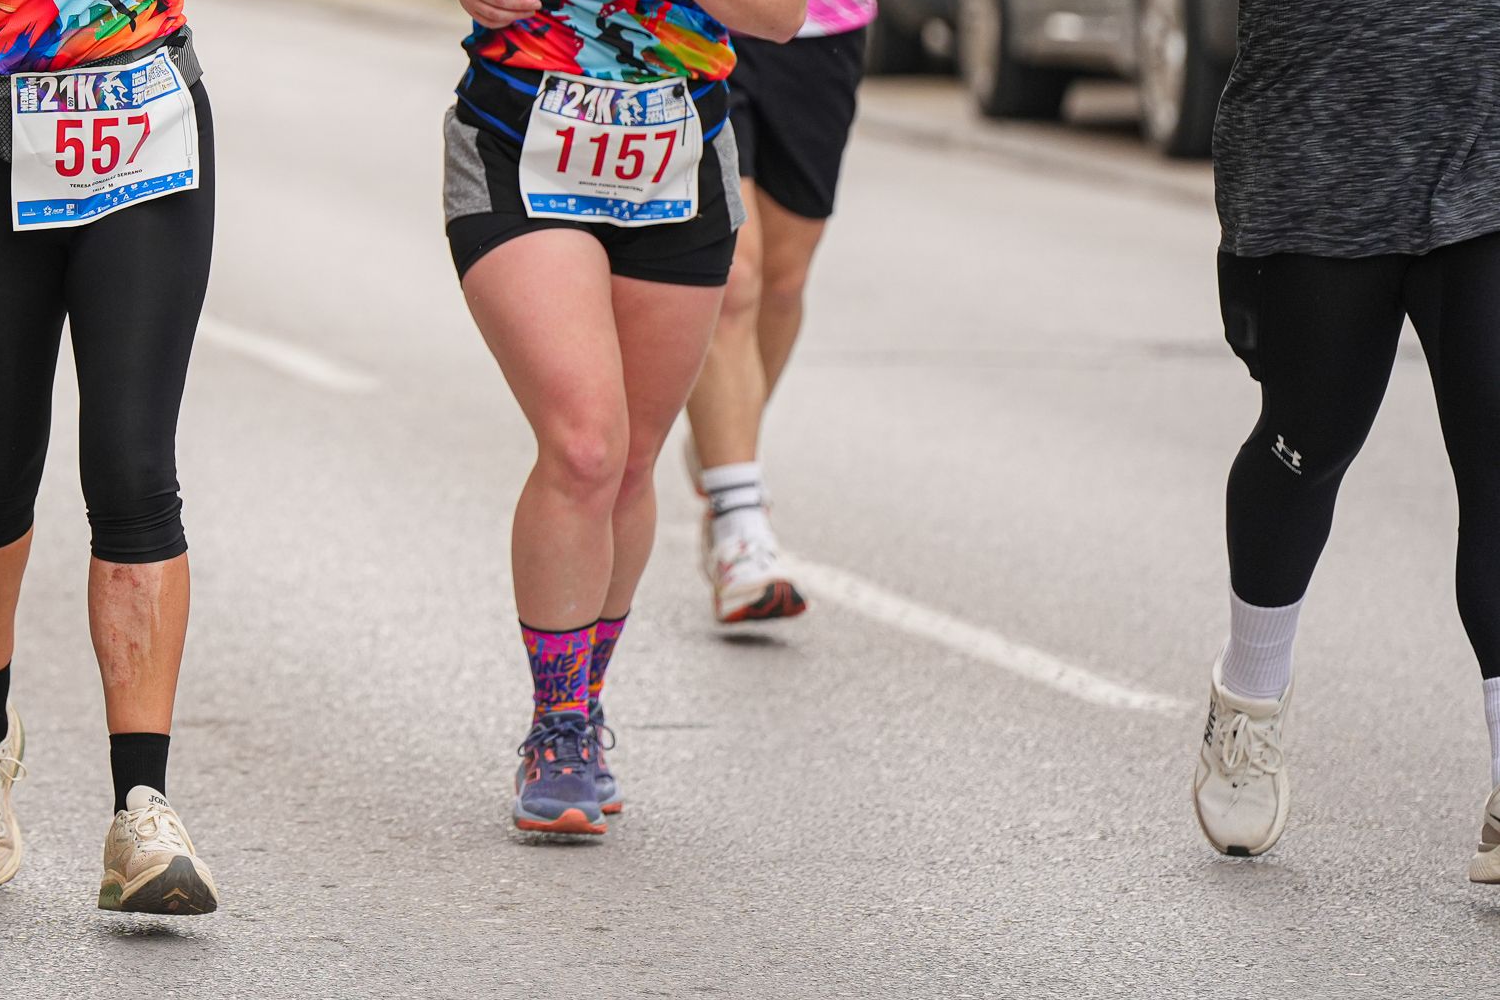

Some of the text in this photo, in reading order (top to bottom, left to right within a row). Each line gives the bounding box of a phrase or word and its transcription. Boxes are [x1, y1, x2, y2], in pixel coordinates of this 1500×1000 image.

[40, 74, 97, 111] 21K
[560, 82, 615, 124] 21K
[55, 112, 151, 177] 557
[556, 126, 677, 184] 1157
[117, 169, 143, 178] SERRANO
